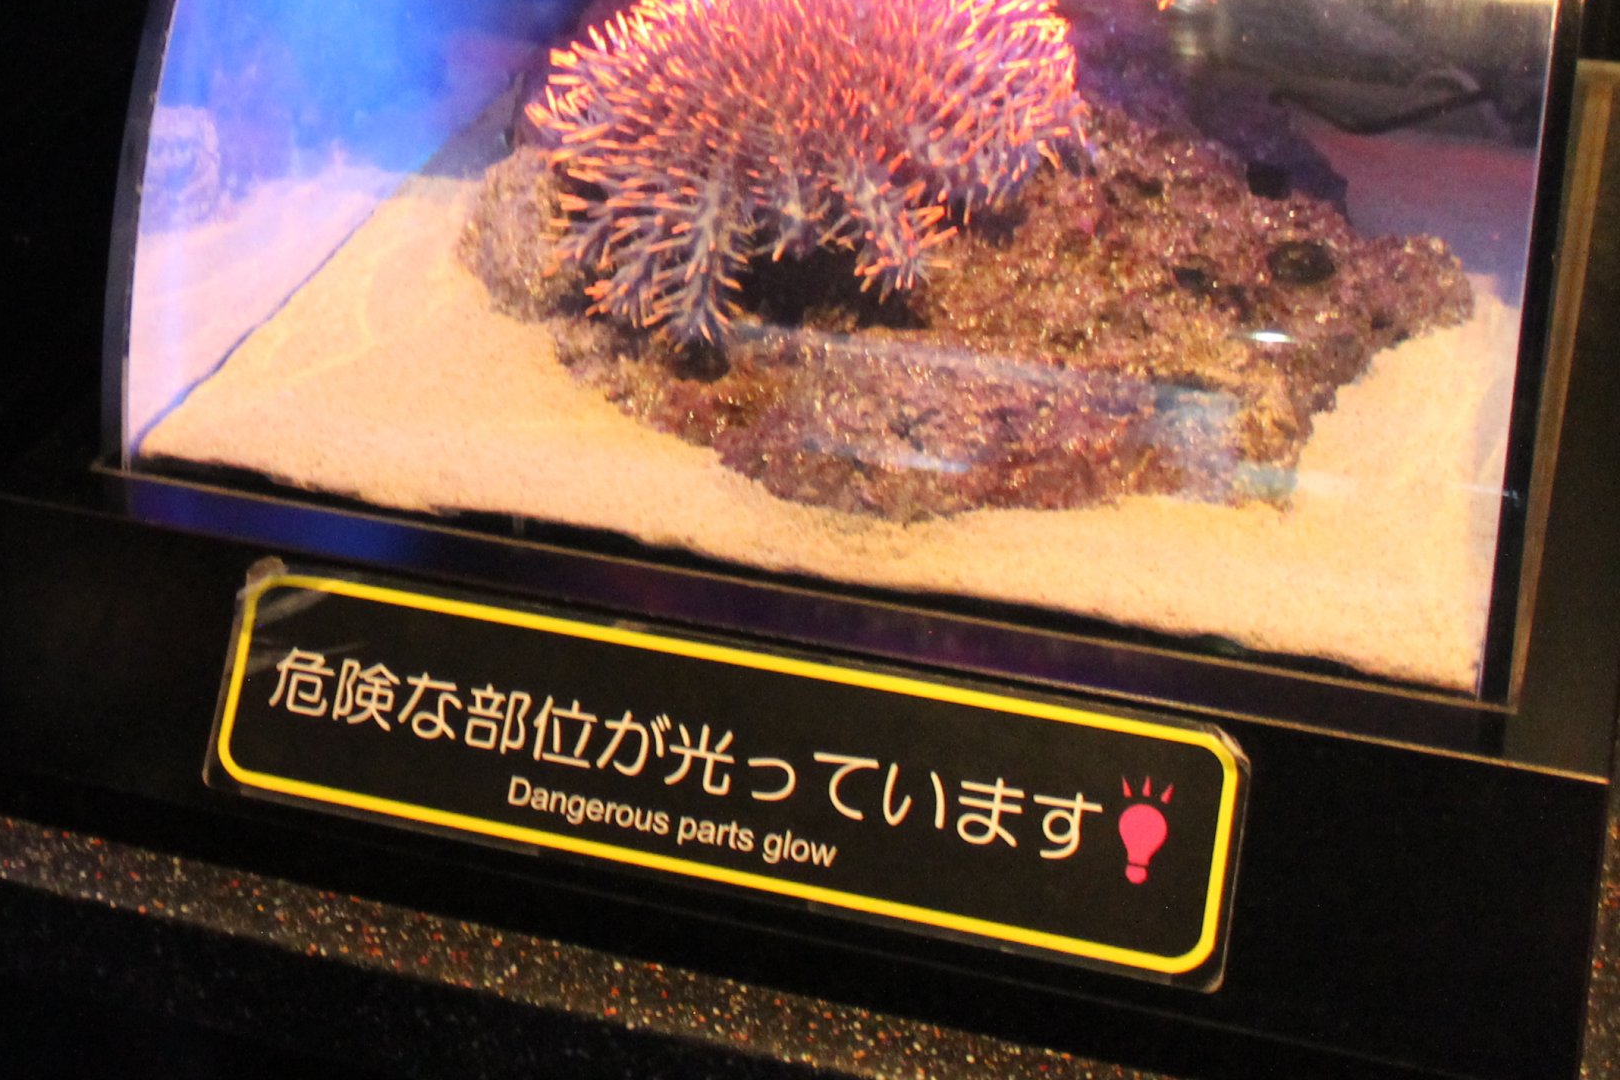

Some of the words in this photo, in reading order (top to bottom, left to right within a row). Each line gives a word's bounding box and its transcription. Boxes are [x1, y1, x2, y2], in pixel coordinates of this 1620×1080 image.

[268, 646, 1103, 860] 危険な部位が光っています
[507, 775, 670, 835] Dangerous
[677, 816, 755, 852] parts
[762, 829, 838, 868] glow
